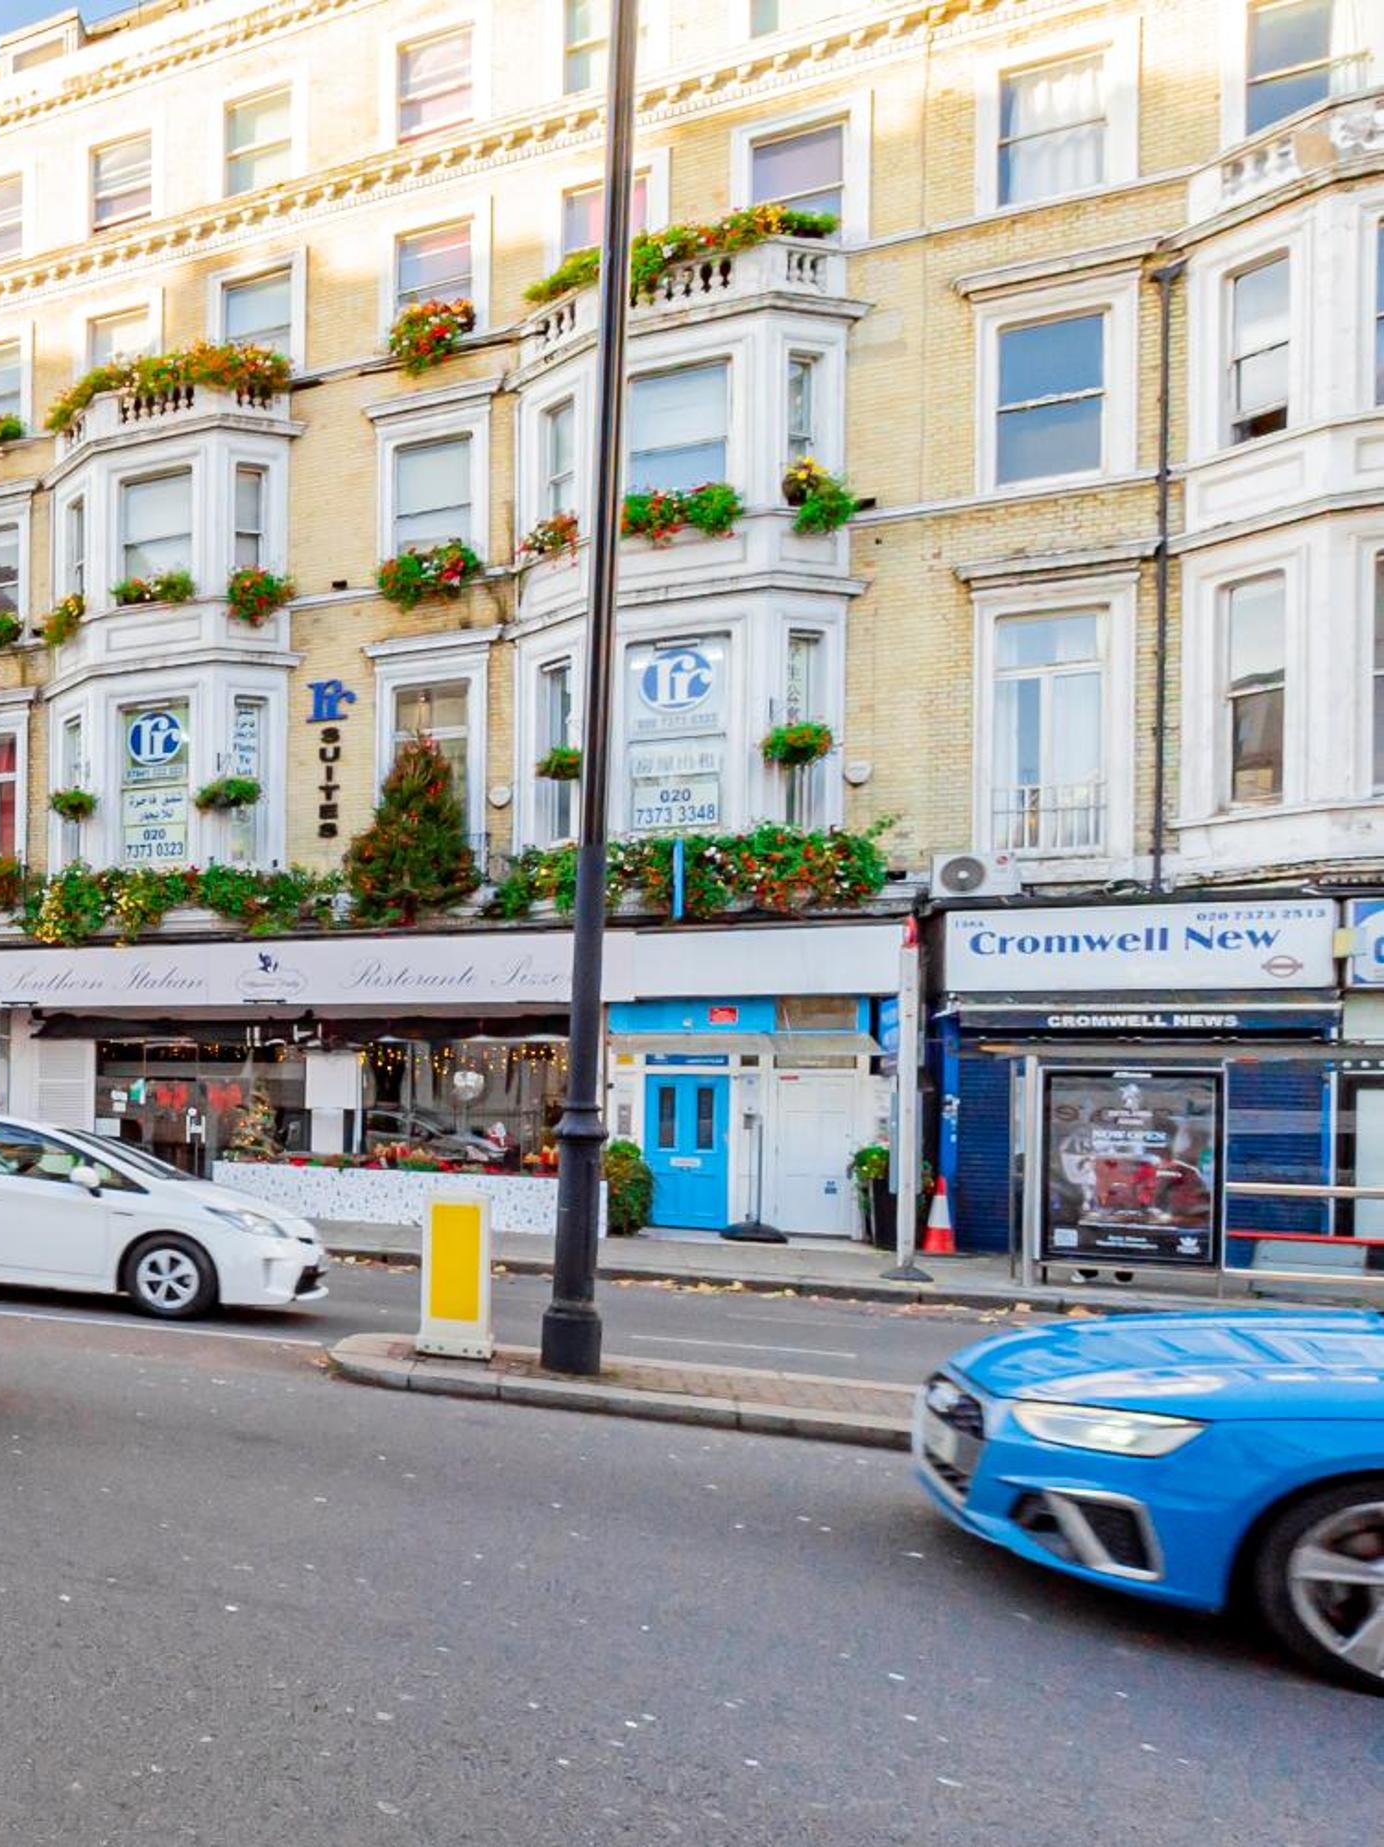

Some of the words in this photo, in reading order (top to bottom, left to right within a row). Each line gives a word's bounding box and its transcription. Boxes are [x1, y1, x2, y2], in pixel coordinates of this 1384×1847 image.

[318, 727, 341, 838] SUITES
[659, 788, 692, 804] 020
[636, 807, 673, 825] 7373
[678, 804, 716, 823] 3348
[143, 828, 166, 841] 020
[126, 843, 153, 859] 7373
[1196, 911, 1229, 922] 020
[969, 928, 1170, 956] Cromwell
[1184, 925, 1282, 952] New
[118, 960, 205, 990] Italian
[347, 957, 476, 989] Ristorante
[1047, 1014, 1167, 1028] CROMWELL
[1173, 1013, 1239, 1027] NEWS
